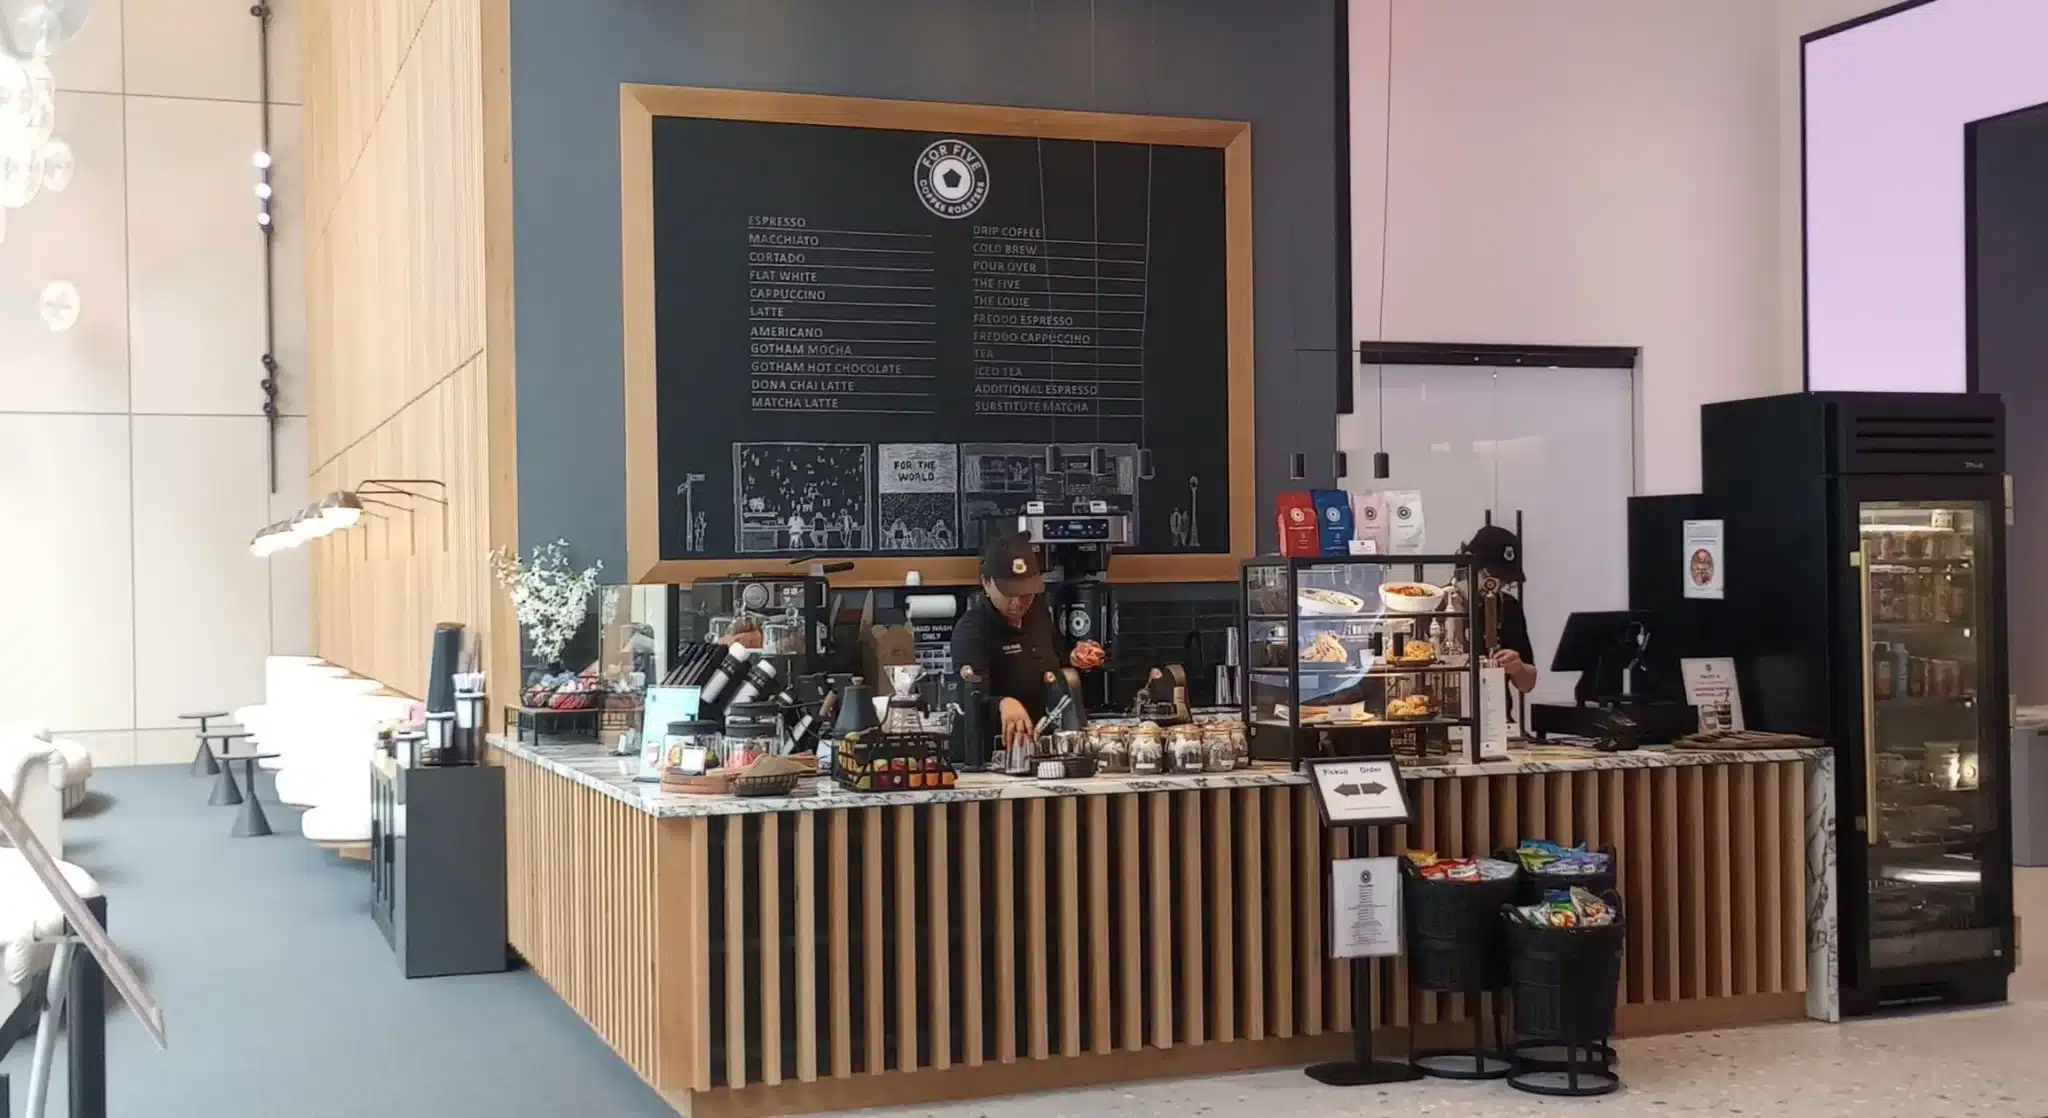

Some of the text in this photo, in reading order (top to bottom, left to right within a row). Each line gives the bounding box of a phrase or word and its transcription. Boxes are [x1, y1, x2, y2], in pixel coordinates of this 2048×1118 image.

[922, 144, 982, 171] FOR FIVE
[919, 179, 985, 215] COFFEE ROASTERS
[748, 215, 806, 228] ESPRESSO
[972, 225, 1041, 238] DRIP COFFEE
[748, 233, 819, 246] MACCHIATO
[972, 243, 1037, 255] COLD BREW
[749, 251, 806, 263] CORTADO
[972, 260, 1037, 273] POUR OVER
[749, 270, 818, 282] FLAT WHITE
[972, 278, 1021, 289] THE FIVE
[750, 288, 826, 300] CAPPUCCINO
[973, 295, 1030, 307] THE LOUIE
[750, 307, 785, 317] LATTE
[973, 314, 1073, 327] FREDDO ESPRESSO
[750, 326, 823, 338] AMERICANO
[973, 331, 1091, 344] FREDDO CAPPUCCINO
[750, 343, 853, 356] GOTHAM MOCHA
[974, 348, 994, 359] TEA
[751, 361, 902, 374] GOTHAM HOT CHOCOLATE
[975, 366, 1023, 377] ICED TEA
[751, 379, 855, 391] DONA CHAI LATTE
[974, 384, 1098, 395] ADDITIONAL ESPRESSO
[752, 397, 839, 409] MATCHA LATTE
[975, 401, 1089, 412] SUBSTITUTE MATCHA
[893, 460, 937, 470] FOR THE
[897, 472, 935, 482] WORLD
[922, 632, 941, 640] ONLY
[1360, 766, 1381, 774] Order
